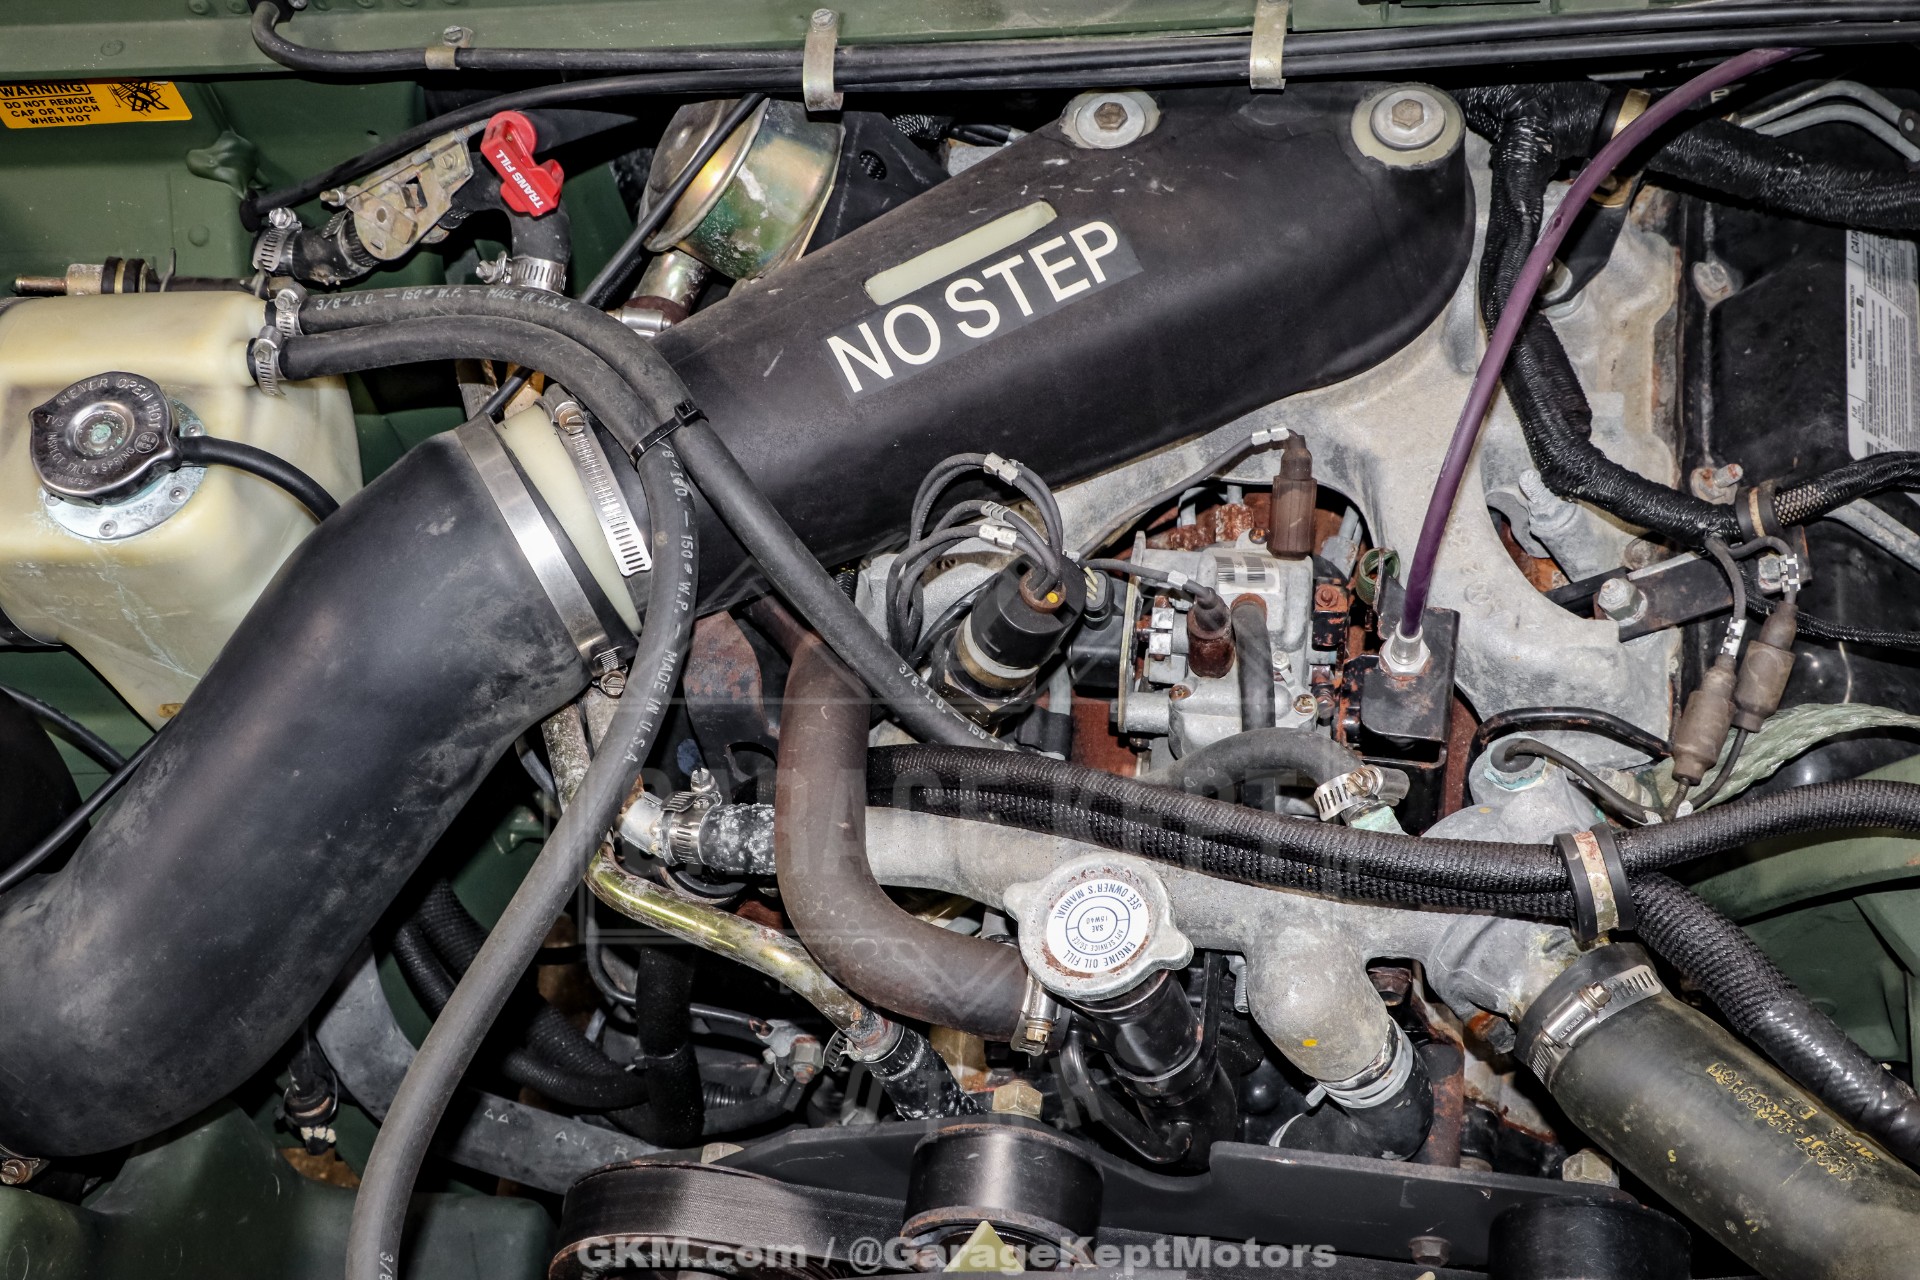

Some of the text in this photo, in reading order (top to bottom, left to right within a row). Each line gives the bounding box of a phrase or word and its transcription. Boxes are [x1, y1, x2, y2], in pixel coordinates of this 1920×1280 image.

[0, 82, 84, 98] WARNING
[4, 97, 97, 110] DO NOT REMOVE
[11, 105, 100, 118] CAP OR TOUCH
[28, 114, 91, 125] WHEN HOT
[495, 149, 544, 209] TRANS FILL
[487, 287, 517, 300] MADE
[827, 221, 1118, 393] NO STEP
[116, 378, 154, 402] OPEN
[146, 403, 163, 428] HOT
[47, 431, 67, 464] INSPECT
[66, 463, 87, 475] FALL
[101, 447, 135, 472] SPRING
[653, 649, 678, 693] MADE
[645, 697, 663, 715] IN
[1054, 883, 1142, 919] SEE OWNER'S MANUAL
[1091, 924, 1104, 933] SAE
[1090, 939, 1116, 952] SERVICE
[1063, 941, 1137, 969] ENGINE OIL FILL
